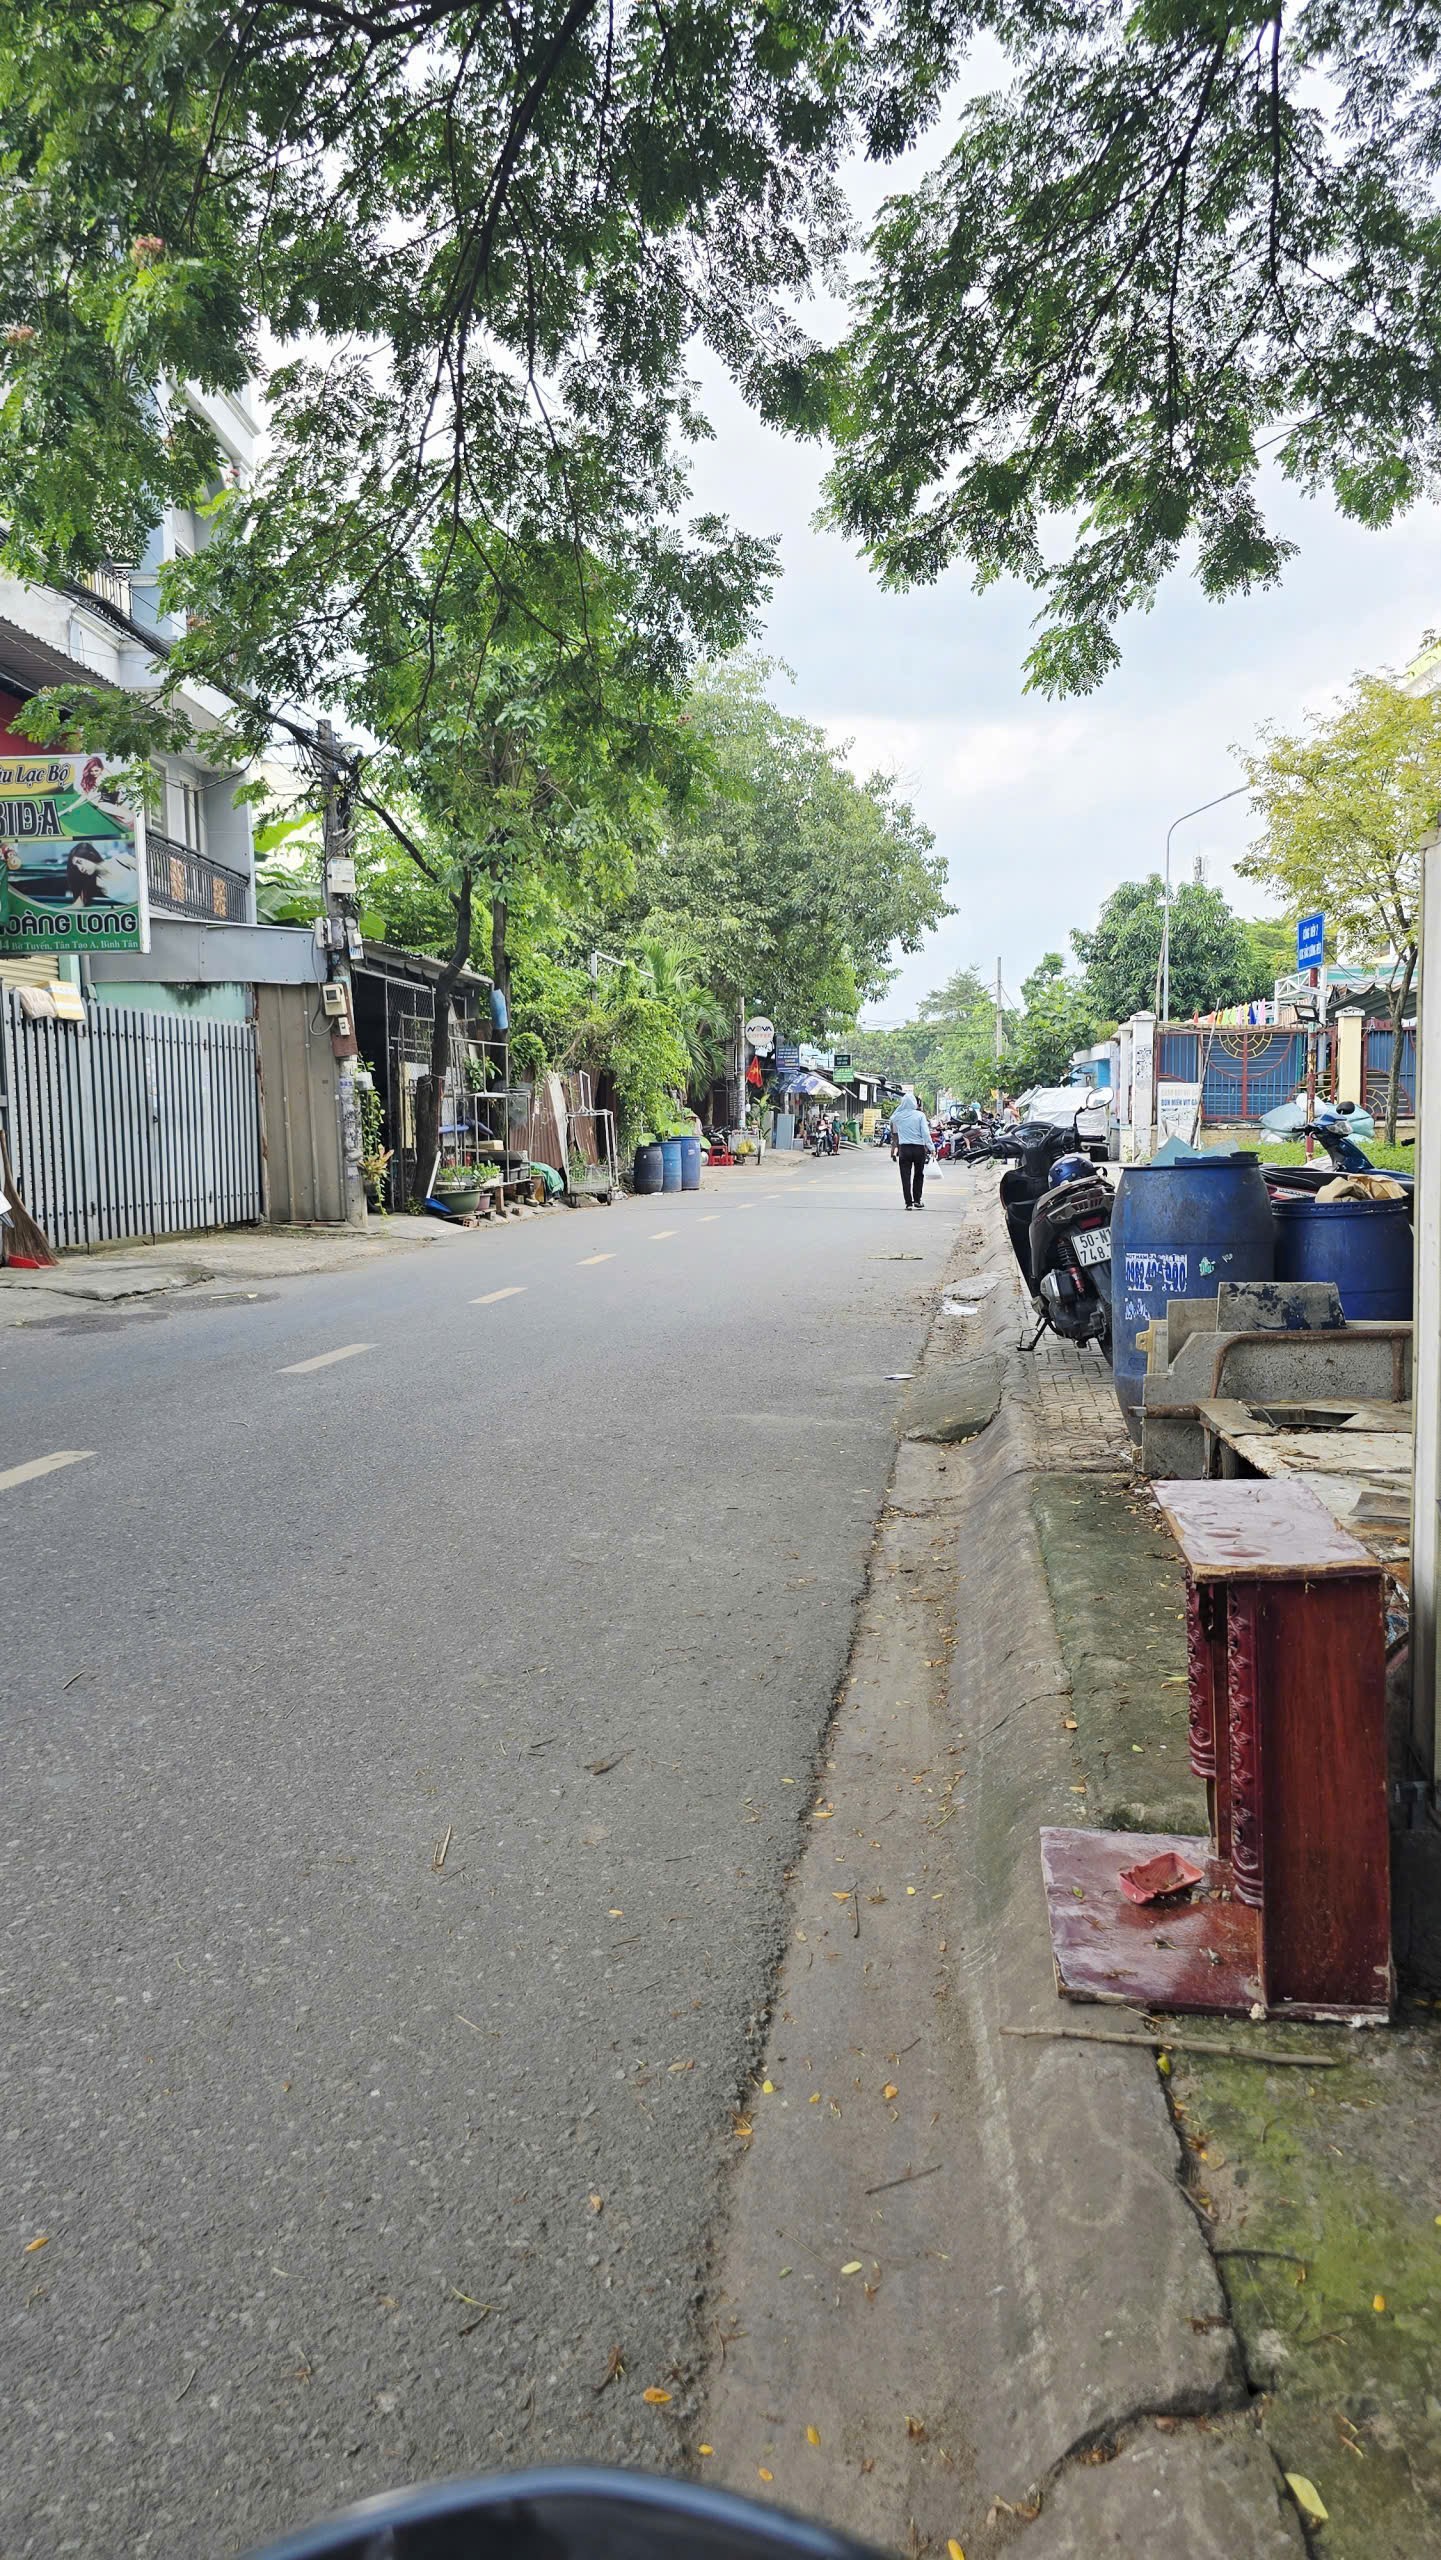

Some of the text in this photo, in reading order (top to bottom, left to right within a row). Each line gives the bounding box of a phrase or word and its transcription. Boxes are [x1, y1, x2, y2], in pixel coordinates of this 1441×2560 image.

[16, 764, 46, 787] Lạc
[47, 763, 71, 787] Bộ
[0, 909, 138, 936] OÀNG LONG
[54, 941, 71, 950] Tân
[100, 939, 120, 949] Bình
[121, 939, 138, 949] Tân
[1080, 1244, 1111, 1264] 748.
